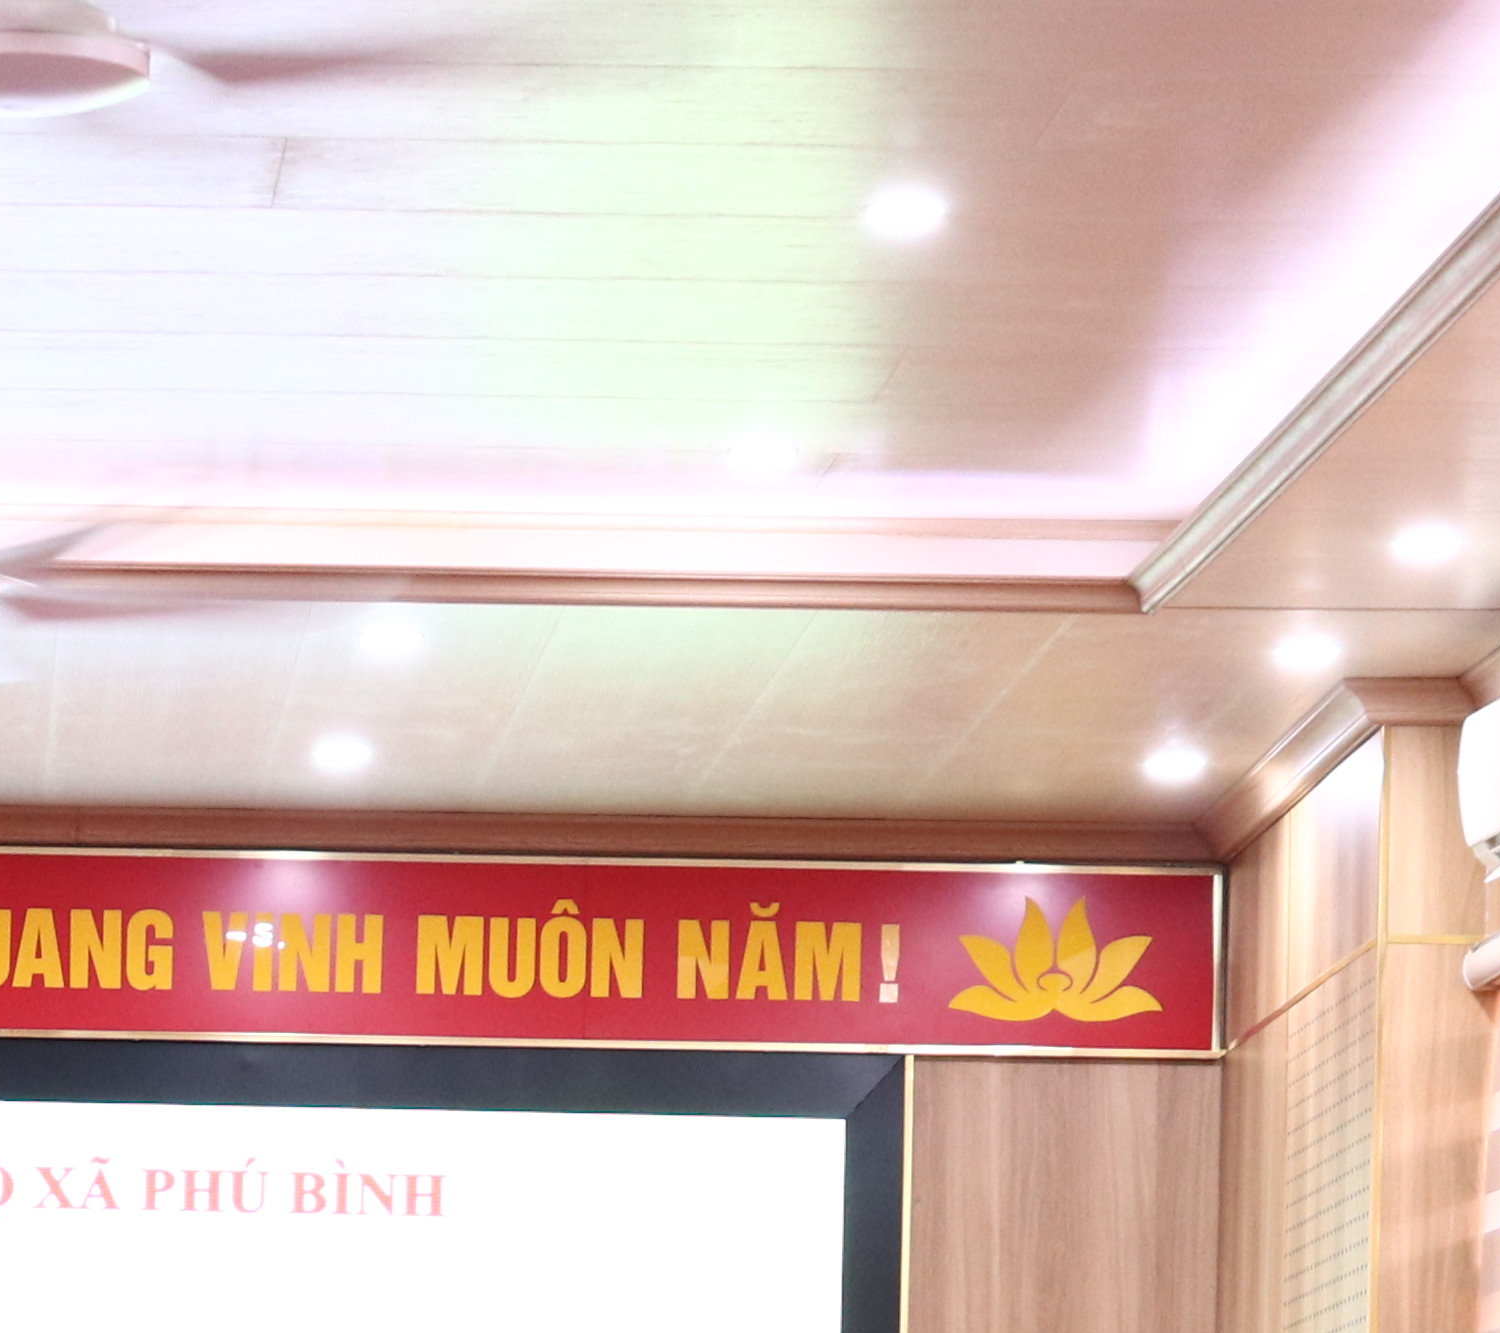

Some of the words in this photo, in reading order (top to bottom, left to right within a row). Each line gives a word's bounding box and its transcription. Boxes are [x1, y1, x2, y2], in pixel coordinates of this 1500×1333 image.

[202, 911, 384, 995] VINH
[416, 899, 643, 998] MUÔN
[35, 1155, 121, 1211] XÃ
[141, 1156, 270, 1214] PHÚ
[289, 1158, 446, 1217] BÌNH
